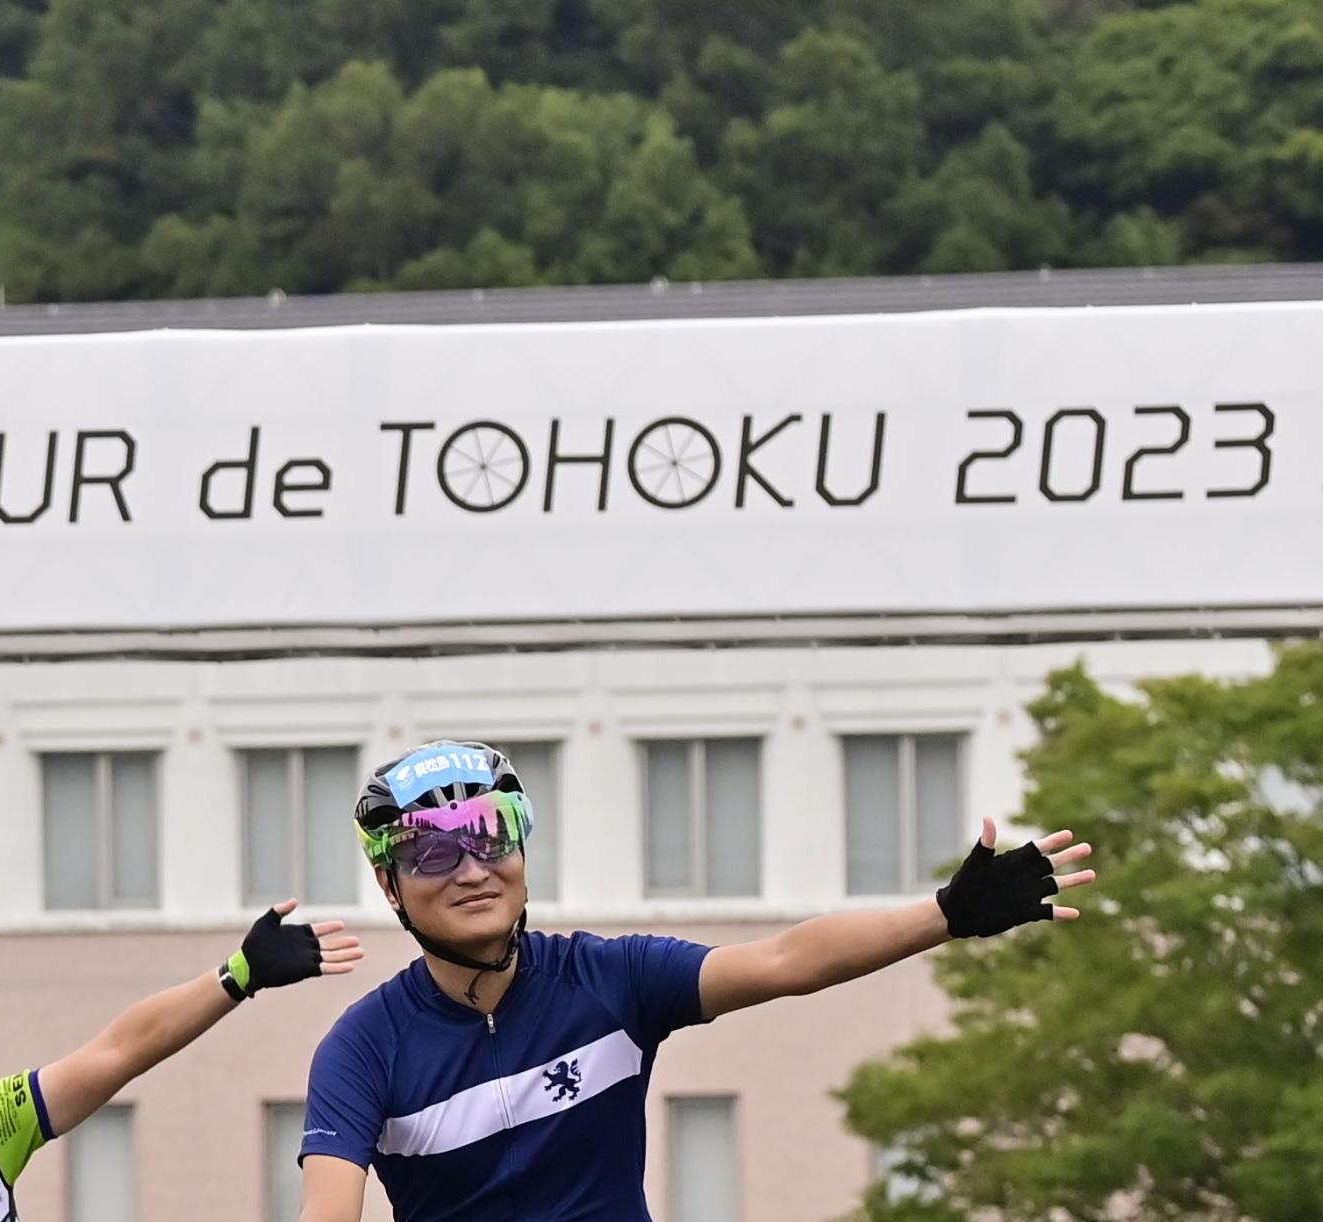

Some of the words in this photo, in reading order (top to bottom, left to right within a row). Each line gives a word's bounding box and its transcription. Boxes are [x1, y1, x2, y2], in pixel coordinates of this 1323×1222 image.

[199, 426, 331, 520] de
[380, 412, 886, 515] TOHOKU
[955, 403, 1275, 504] 2023
